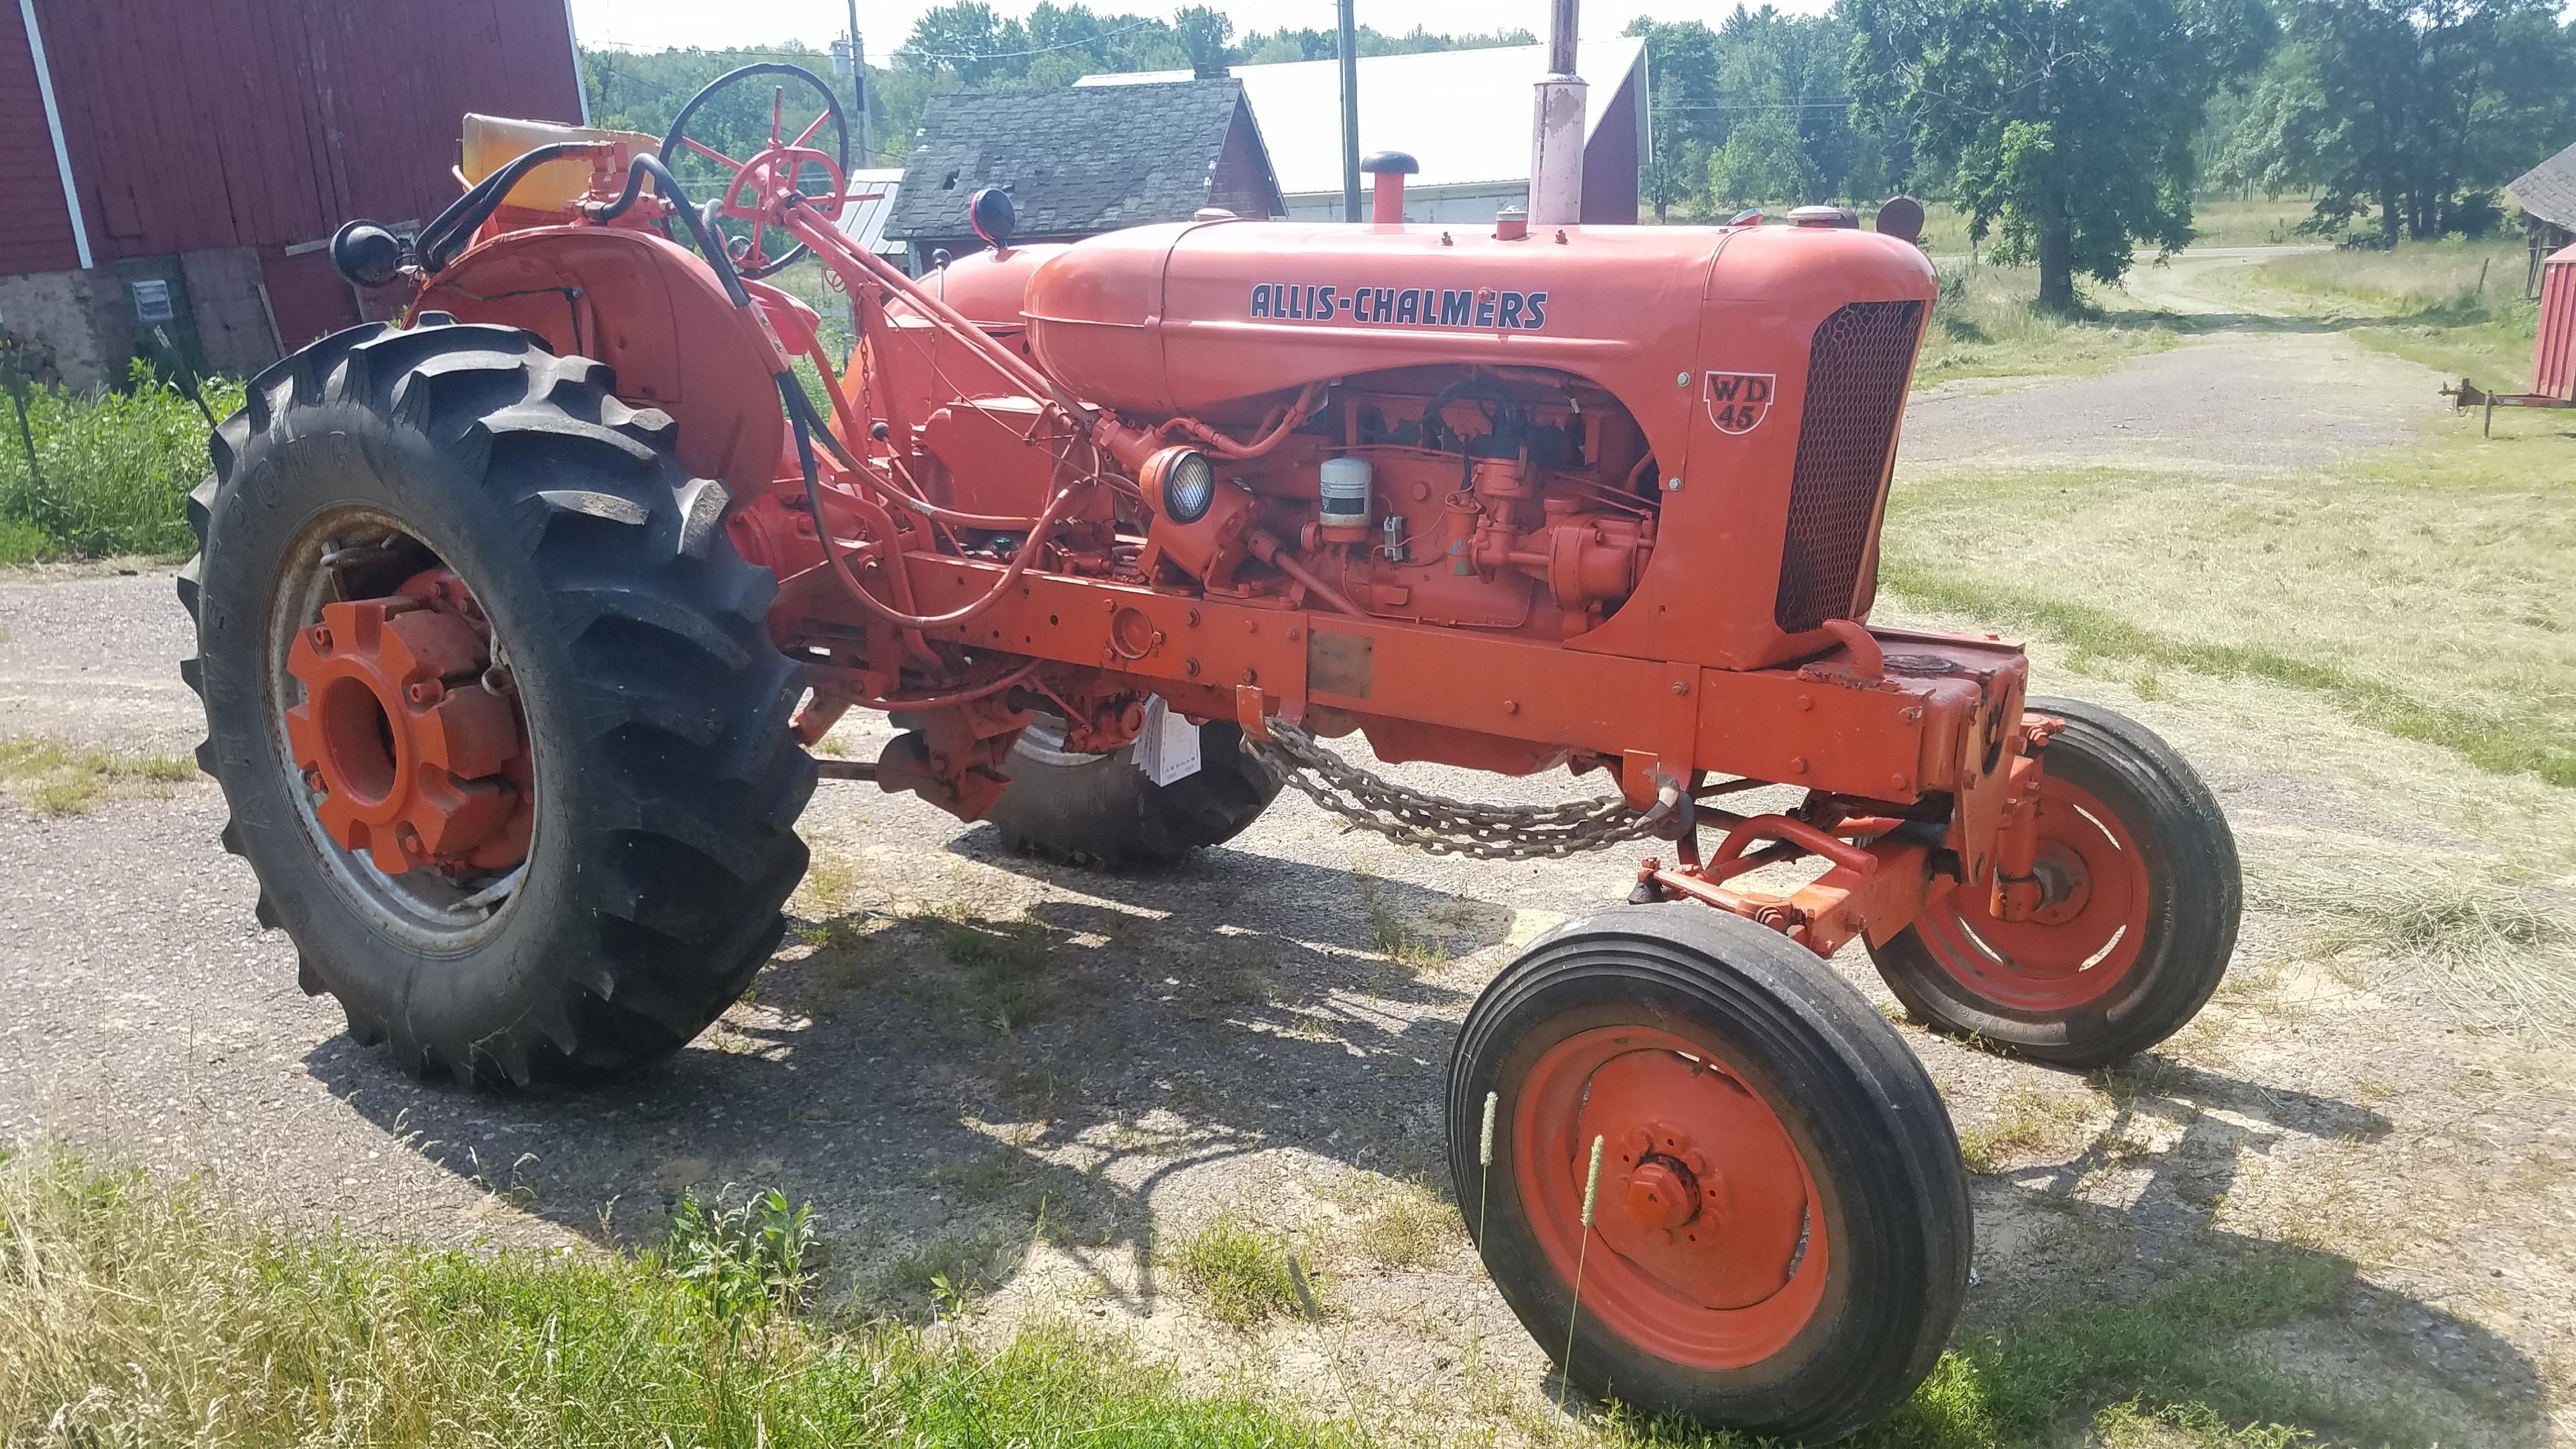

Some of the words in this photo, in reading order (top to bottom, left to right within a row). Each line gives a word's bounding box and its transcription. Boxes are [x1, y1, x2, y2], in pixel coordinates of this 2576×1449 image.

[1250, 282, 1548, 330] ALLIS-CHALMERS
[1709, 375, 1769, 402] WD
[1717, 404, 1756, 429] 45
